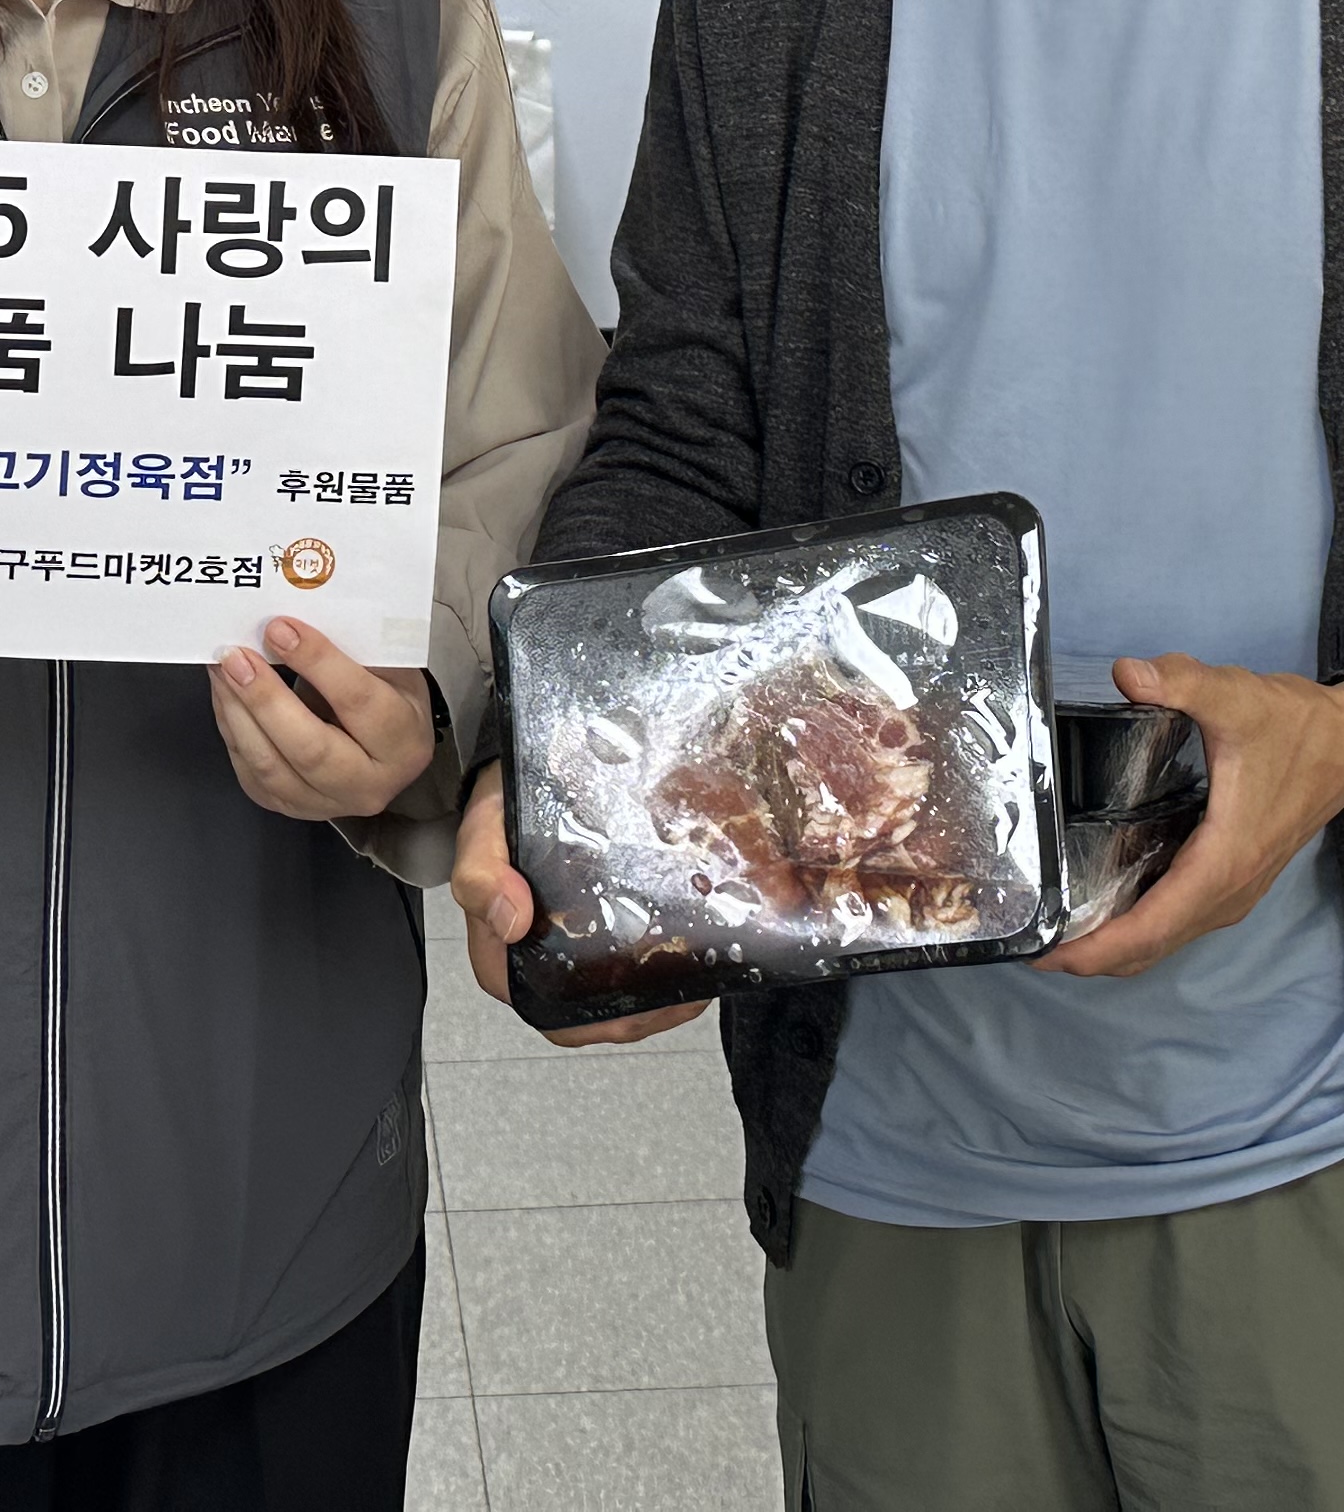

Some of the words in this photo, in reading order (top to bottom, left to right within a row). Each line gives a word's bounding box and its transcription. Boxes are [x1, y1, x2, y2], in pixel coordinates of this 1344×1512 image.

[166, 120, 240, 145] Food
[88, 175, 393, 283] 사랑의
[111, 300, 316, 402] 나눔
[275, 469, 416, 506] 후원물품
